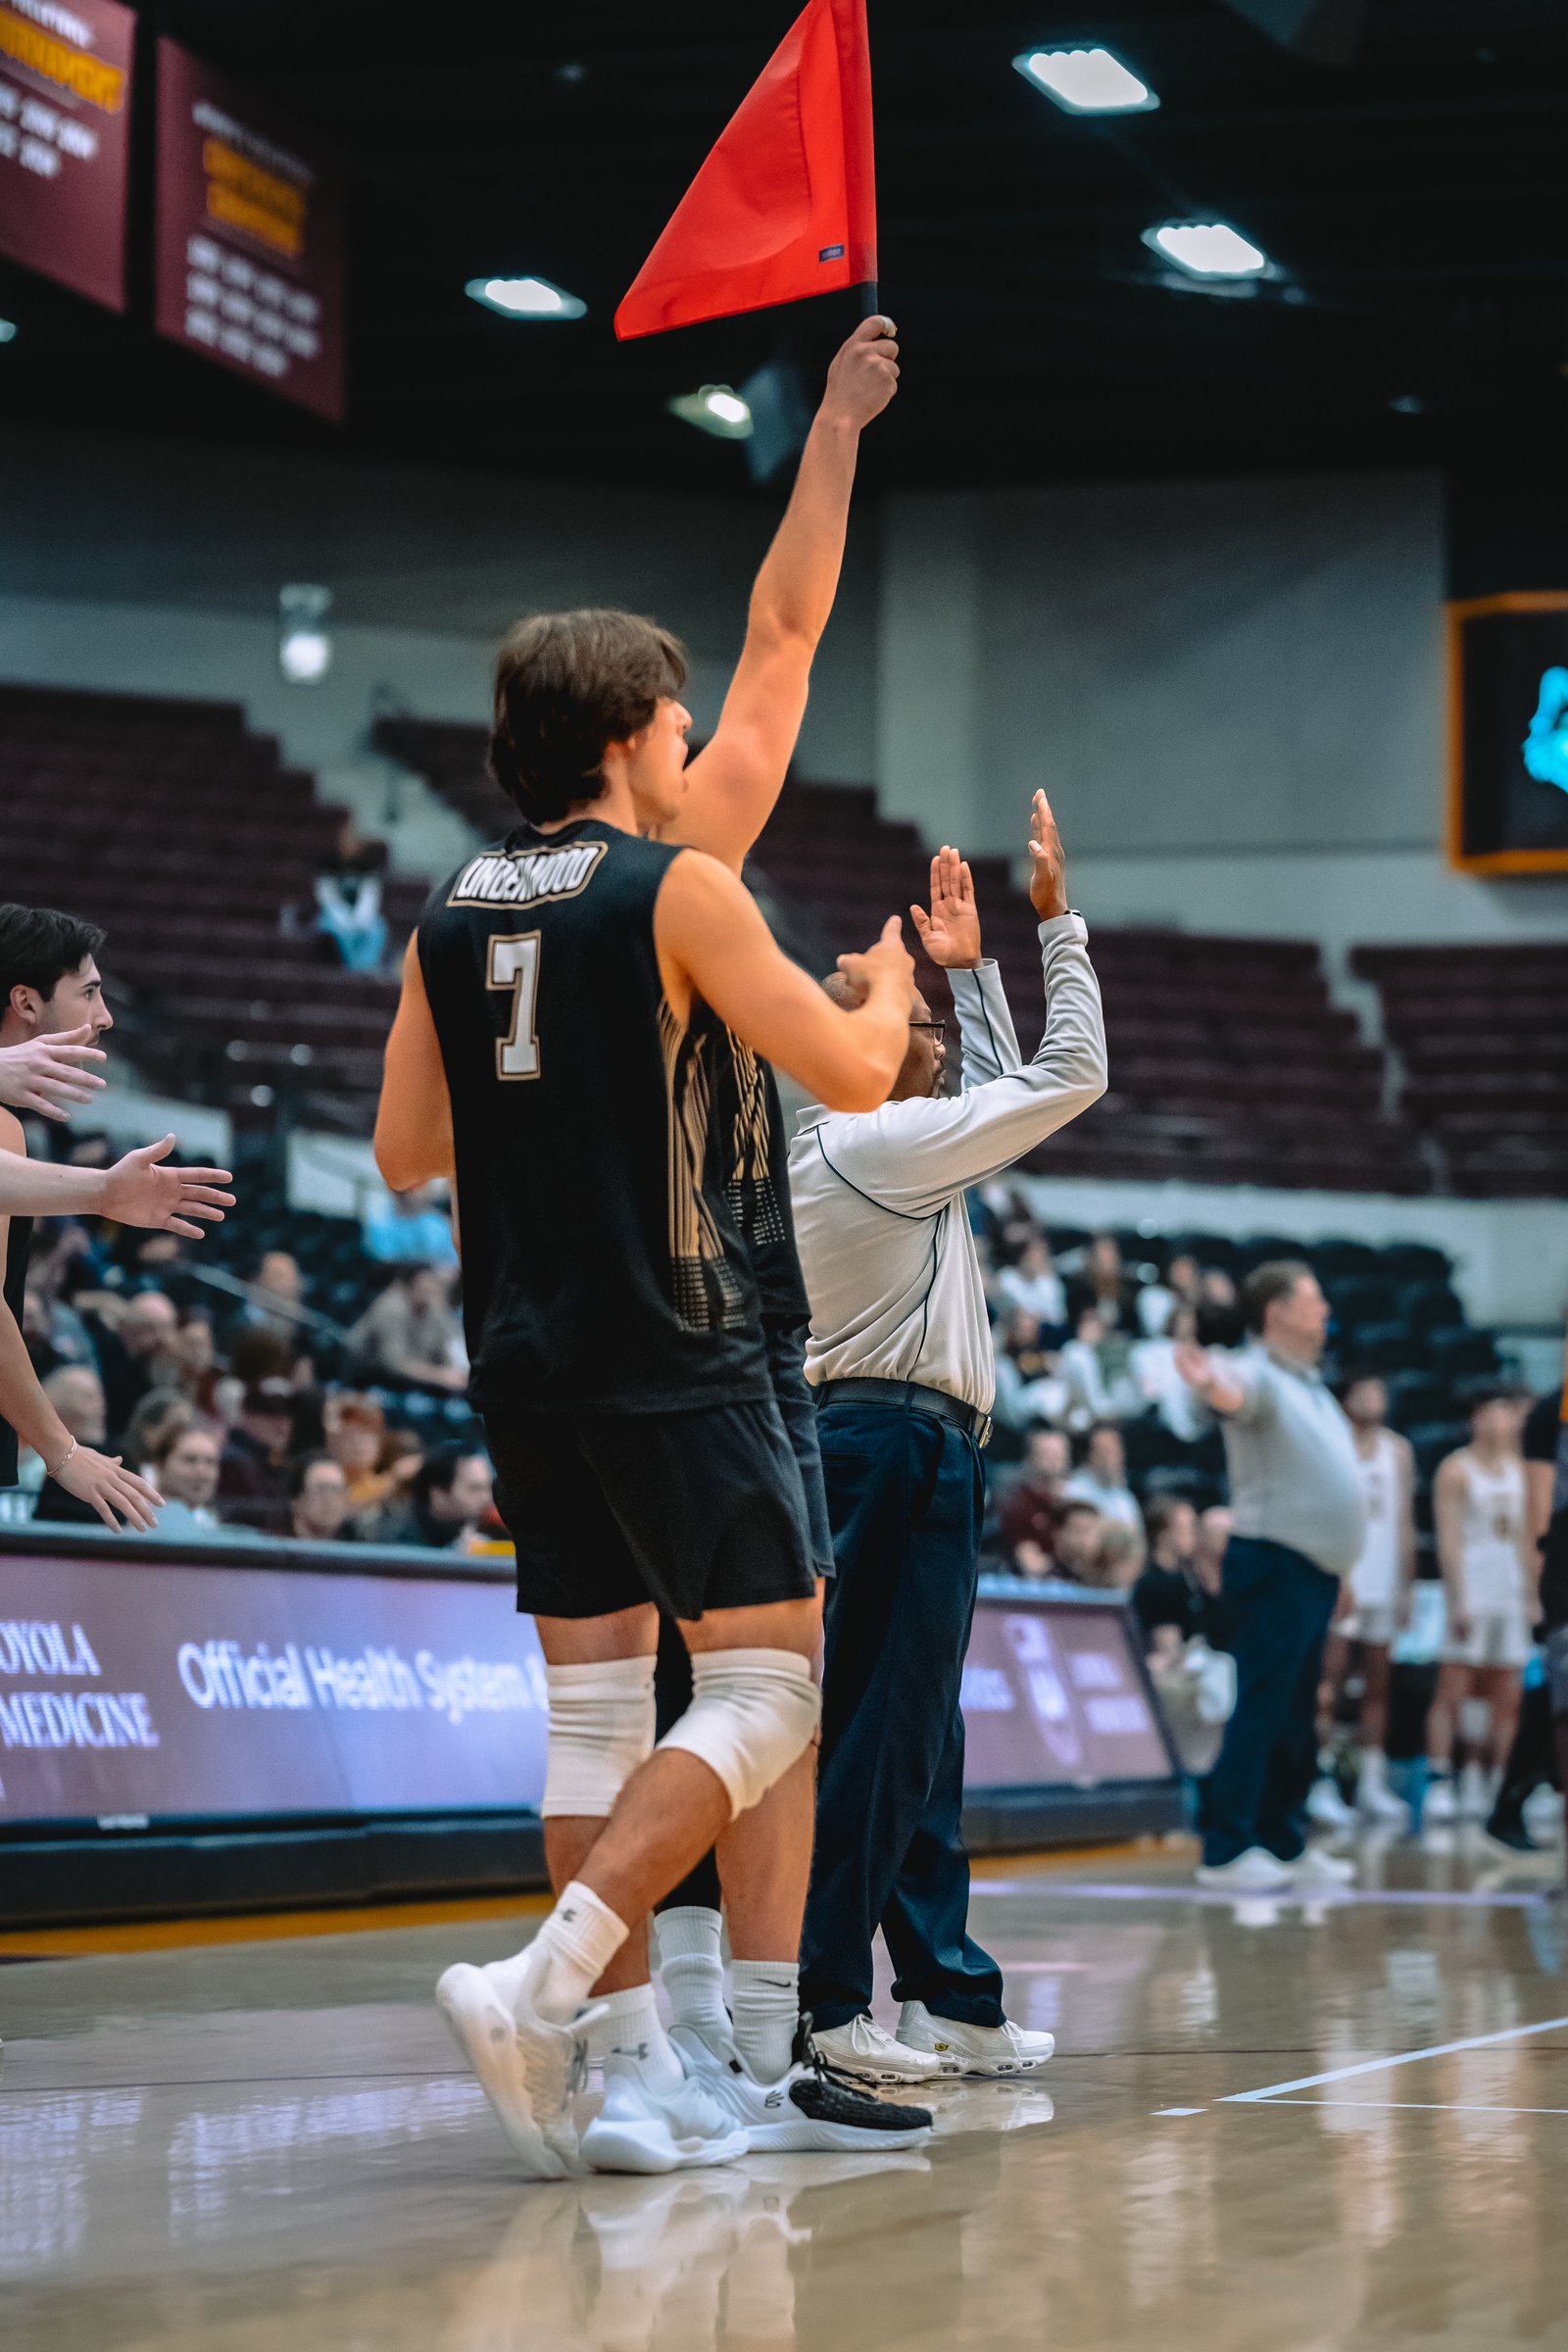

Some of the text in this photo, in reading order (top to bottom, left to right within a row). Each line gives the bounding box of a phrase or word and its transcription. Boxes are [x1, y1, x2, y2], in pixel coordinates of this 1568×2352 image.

[487, 931, 541, 1080] 7
[0, 1621, 101, 1676] OYOLA
[177, 1640, 313, 1709] Official
[305, 1643, 423, 1710] Health
[415, 1648, 534, 1725] System
[0, 1692, 160, 1747] MEDICINE
